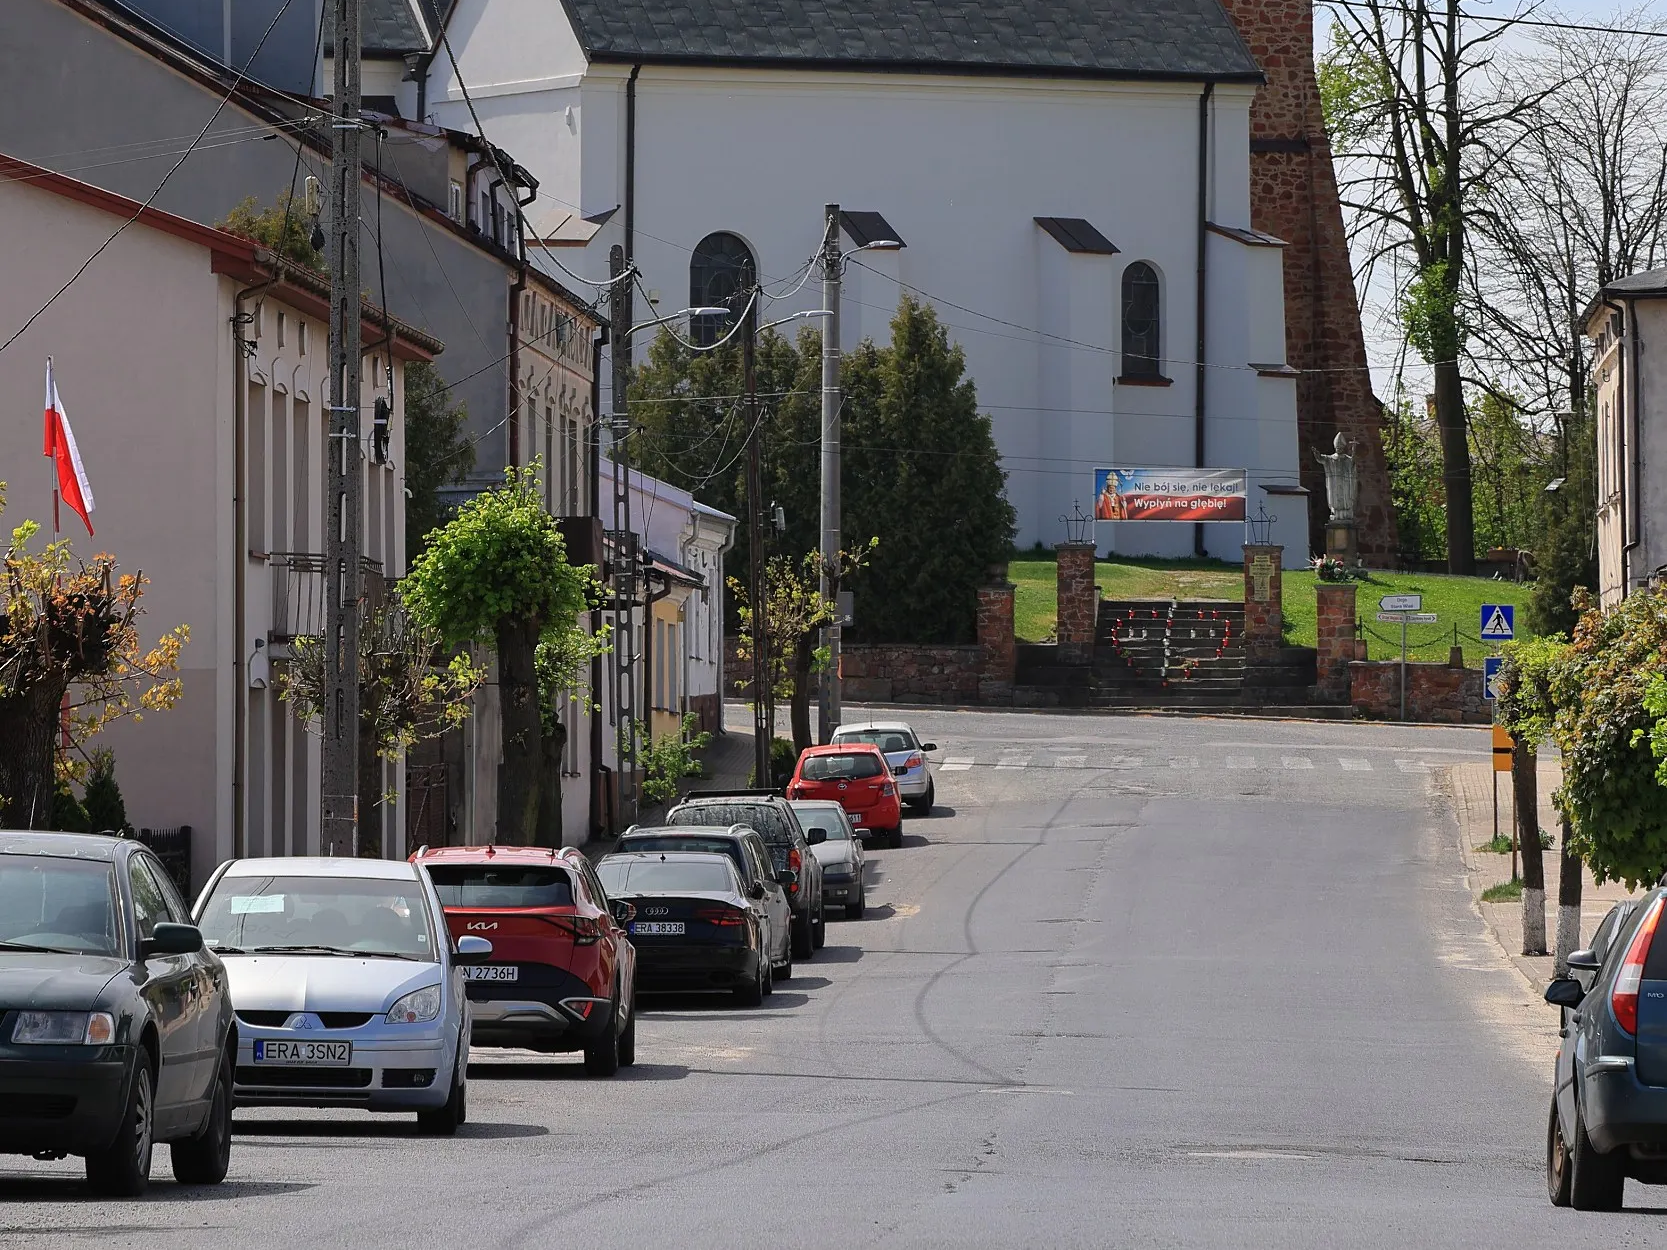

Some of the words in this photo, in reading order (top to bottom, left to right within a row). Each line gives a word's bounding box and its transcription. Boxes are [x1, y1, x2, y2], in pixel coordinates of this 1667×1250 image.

[1134, 482, 1151, 491] Nie
[1153, 482, 1170, 493] bój
[1172, 482, 1190, 493] się,
[1192, 482, 1208, 491] nie
[1174, 499, 1188, 508] na
[635, 923, 653, 933] ERA
[655, 923, 684, 933] 38338
[475, 967, 515, 980] 2736H
[265, 1043, 301, 1059] ERA
[306, 1043, 347, 1061] 3SN2
